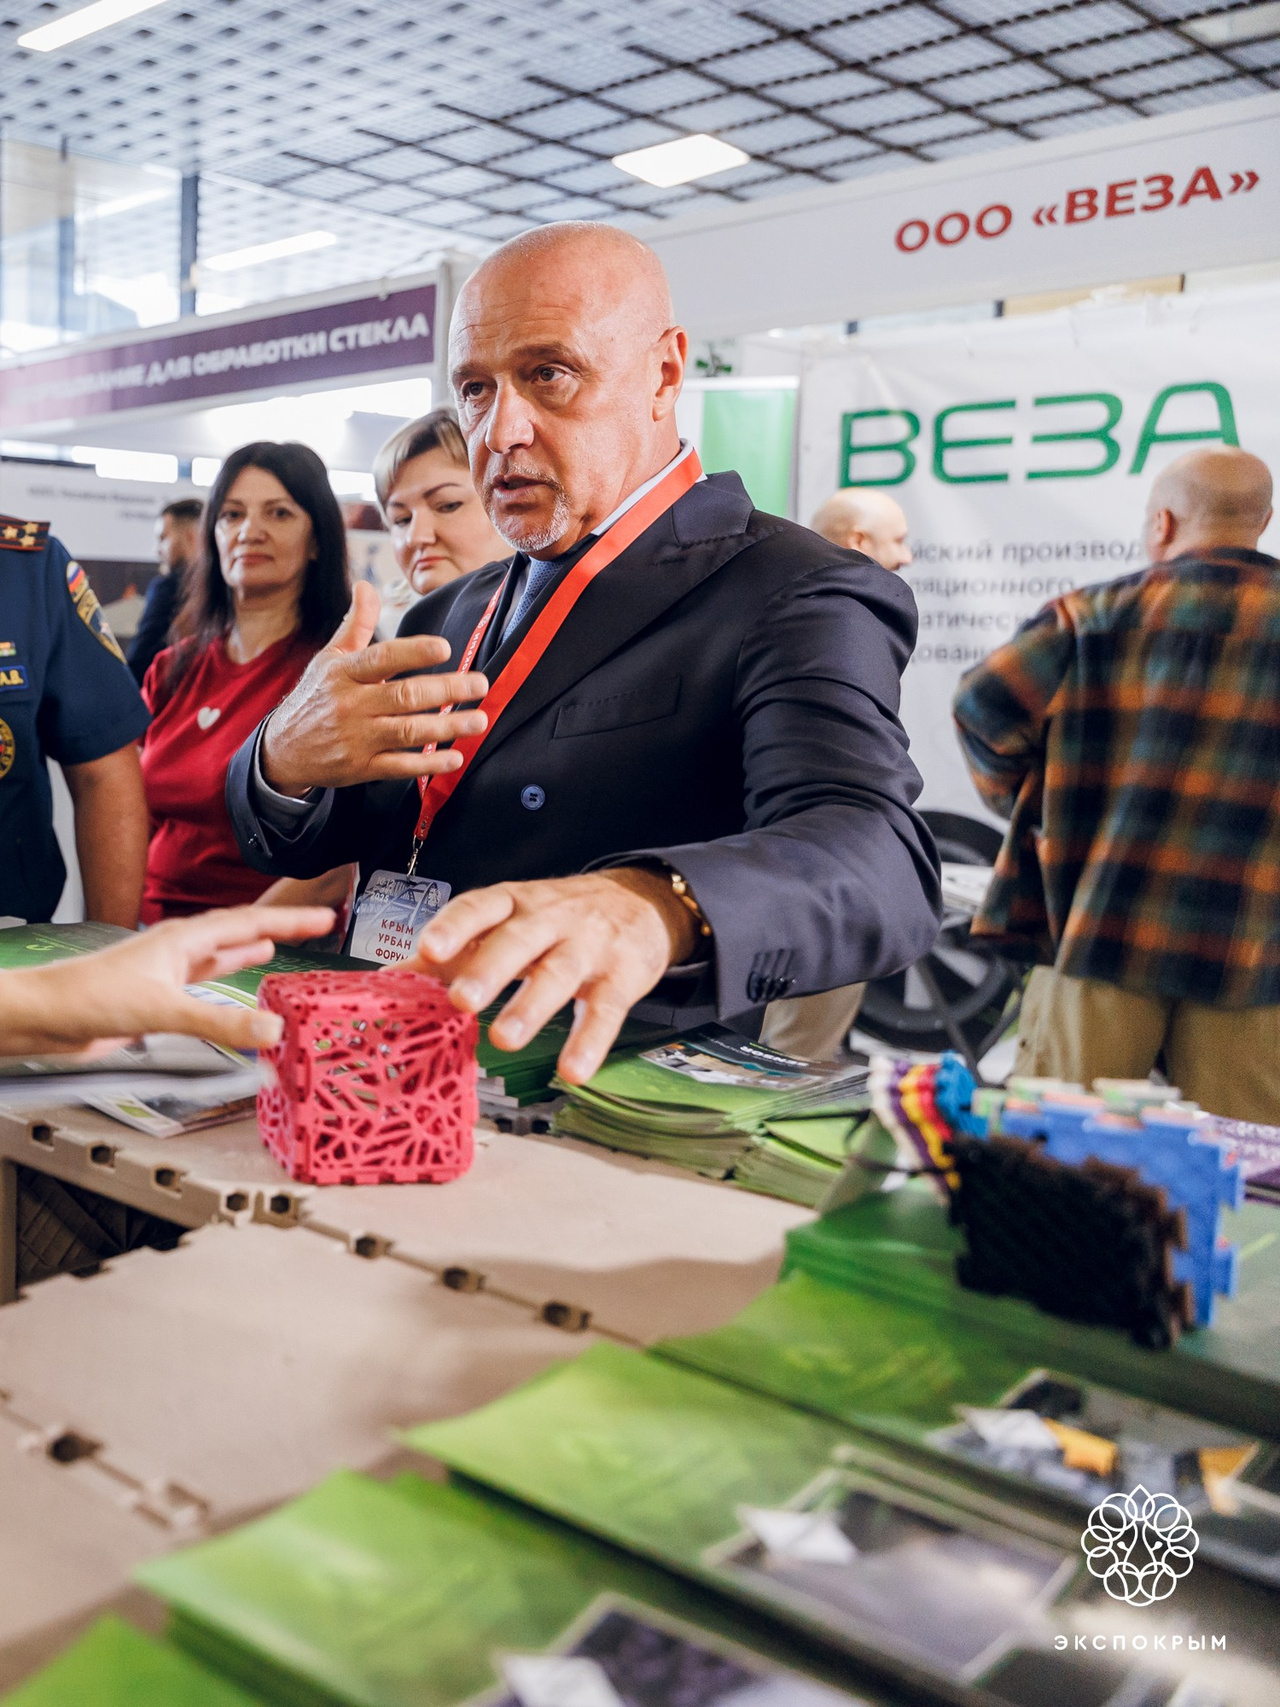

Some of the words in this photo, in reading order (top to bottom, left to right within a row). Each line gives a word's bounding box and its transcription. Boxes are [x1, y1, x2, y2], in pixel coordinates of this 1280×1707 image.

[895, 204, 1013, 253] ООО
[1032, 165, 1260, 226] «ВЕЗА»
[144, 354, 191, 387] ДЛЯ
[193, 331, 326, 376] ОБРАБОТКИ
[328, 313, 430, 354] СТЕКЛА
[839, 381, 1240, 489] ВЕЗА
[378, 933, 412, 950] УРБАН
[381, 919, 414, 935] КРЫМ
